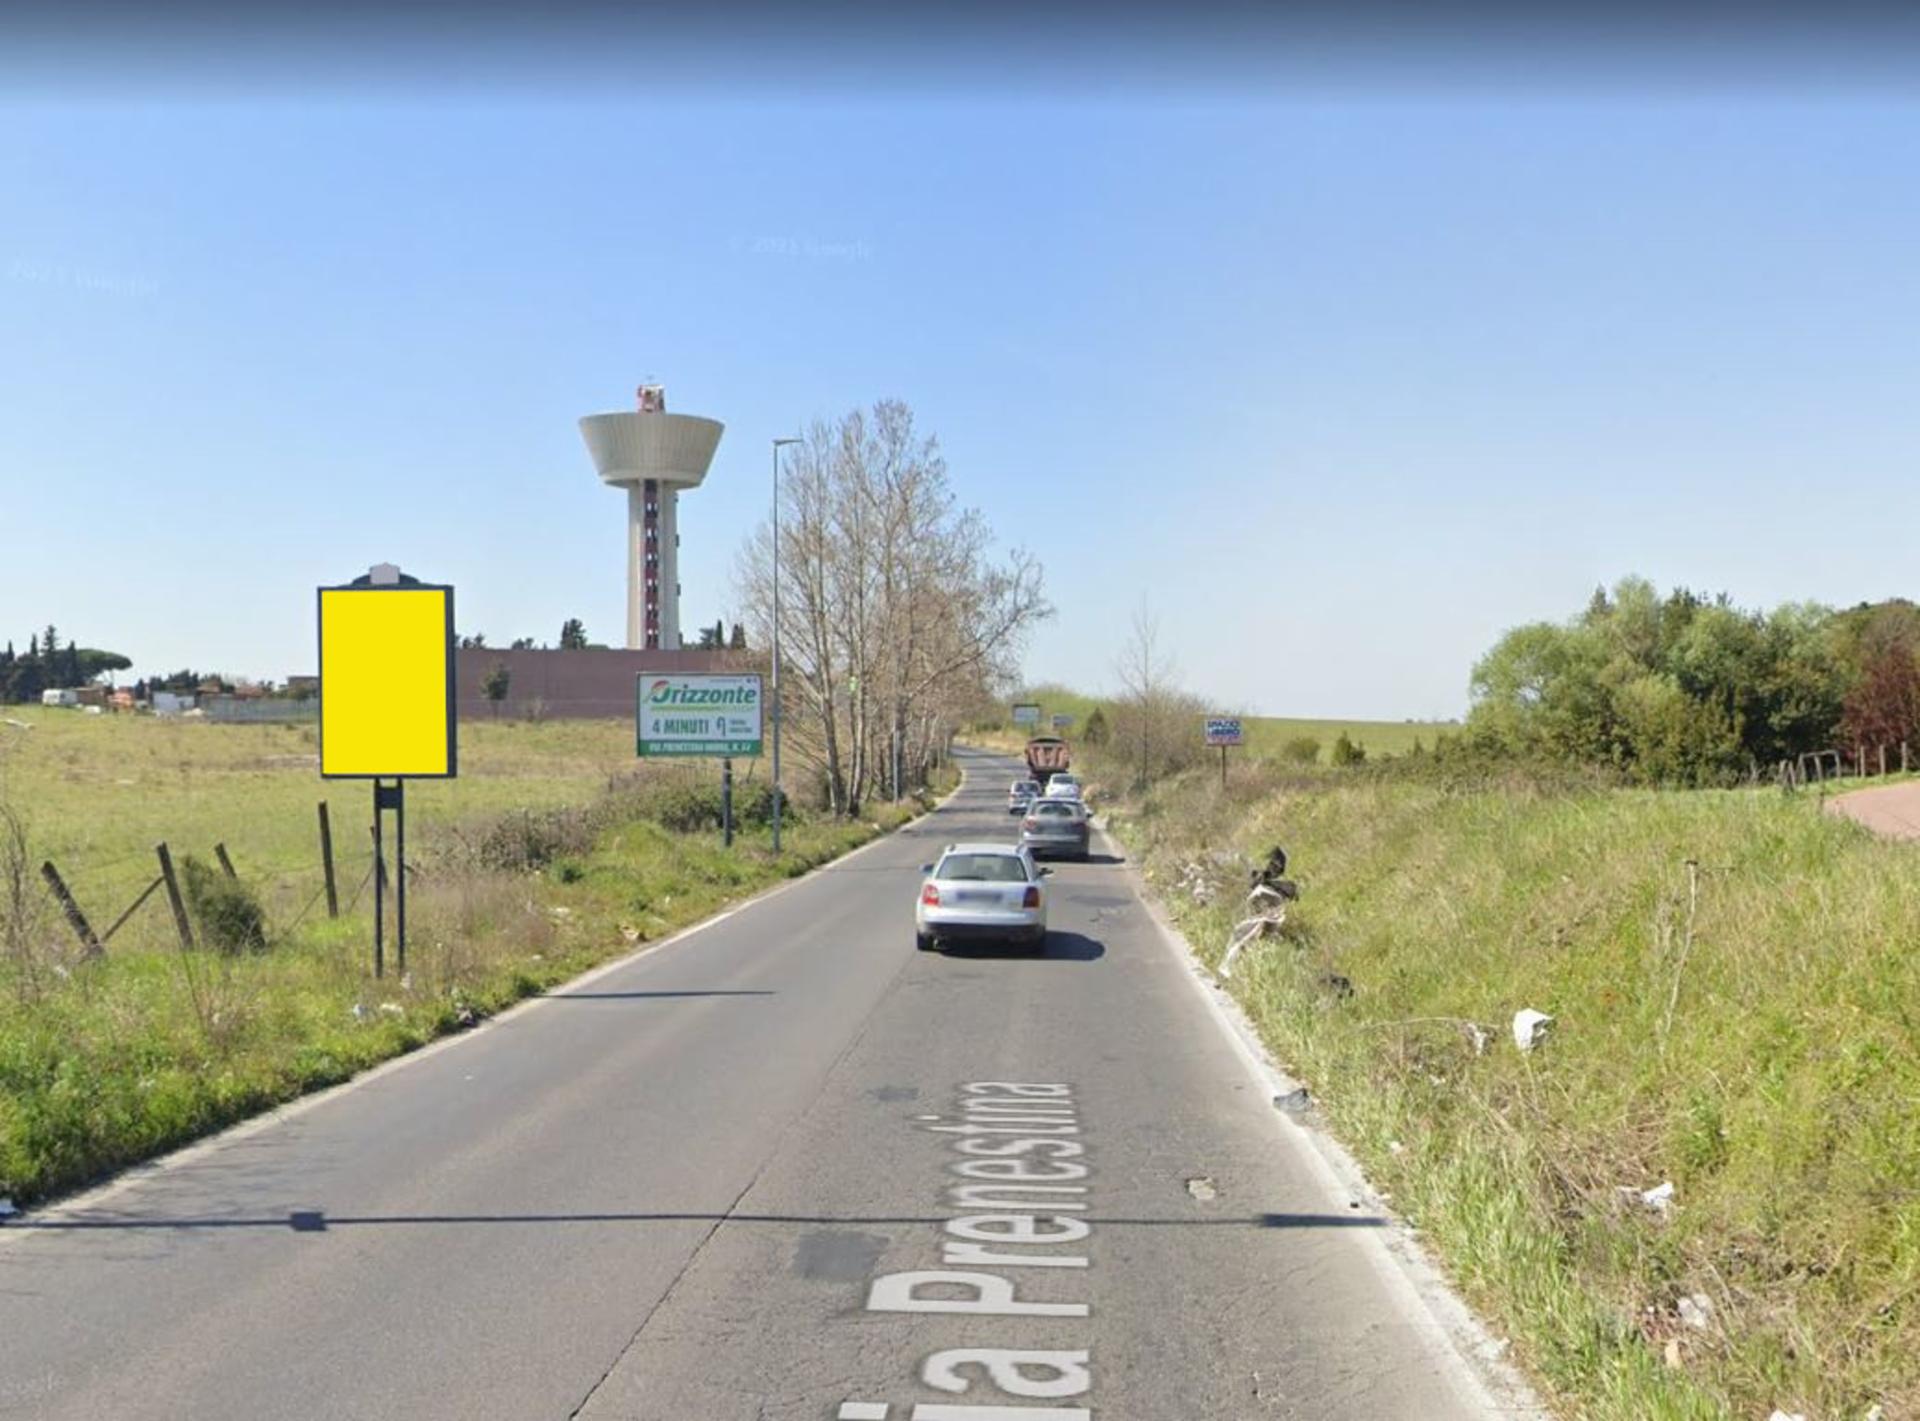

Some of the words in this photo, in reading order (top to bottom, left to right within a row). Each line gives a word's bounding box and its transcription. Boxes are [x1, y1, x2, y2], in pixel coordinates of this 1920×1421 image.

[651, 680, 757, 704] Orizzonte
[652, 719, 660, 734] 4
[663, 719, 710, 734] MINUTI
